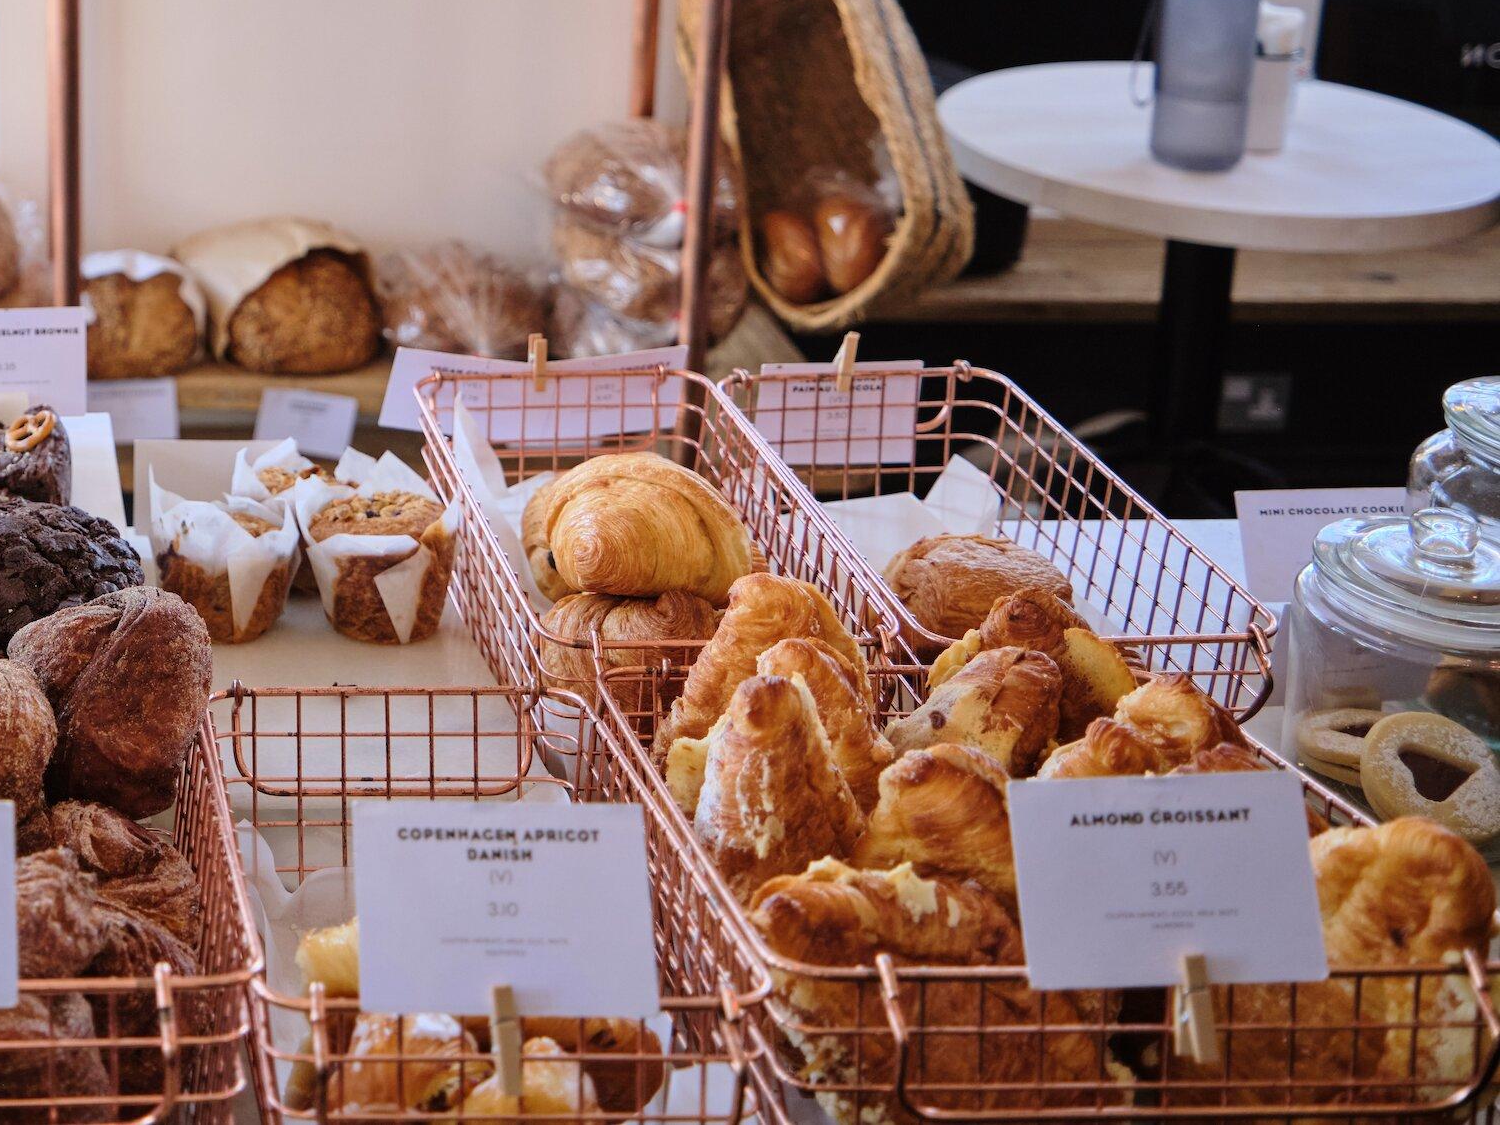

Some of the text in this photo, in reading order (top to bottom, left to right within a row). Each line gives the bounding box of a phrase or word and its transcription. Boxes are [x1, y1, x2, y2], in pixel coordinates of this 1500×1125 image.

[34, 327, 79, 336] BROWNIE
[1259, 508, 1285, 516] MINI
[1288, 506, 1358, 516] CHOCOLATE
[1070, 808, 1251, 826] ALMOND CROISSANT
[397, 827, 600, 843] COPENHAGEN APRICOT
[467, 848, 533, 862] DANISH
[1153, 850, 1177, 867] (V)
[489, 869, 514, 886] (V)
[1151, 881, 1188, 898] 3.55
